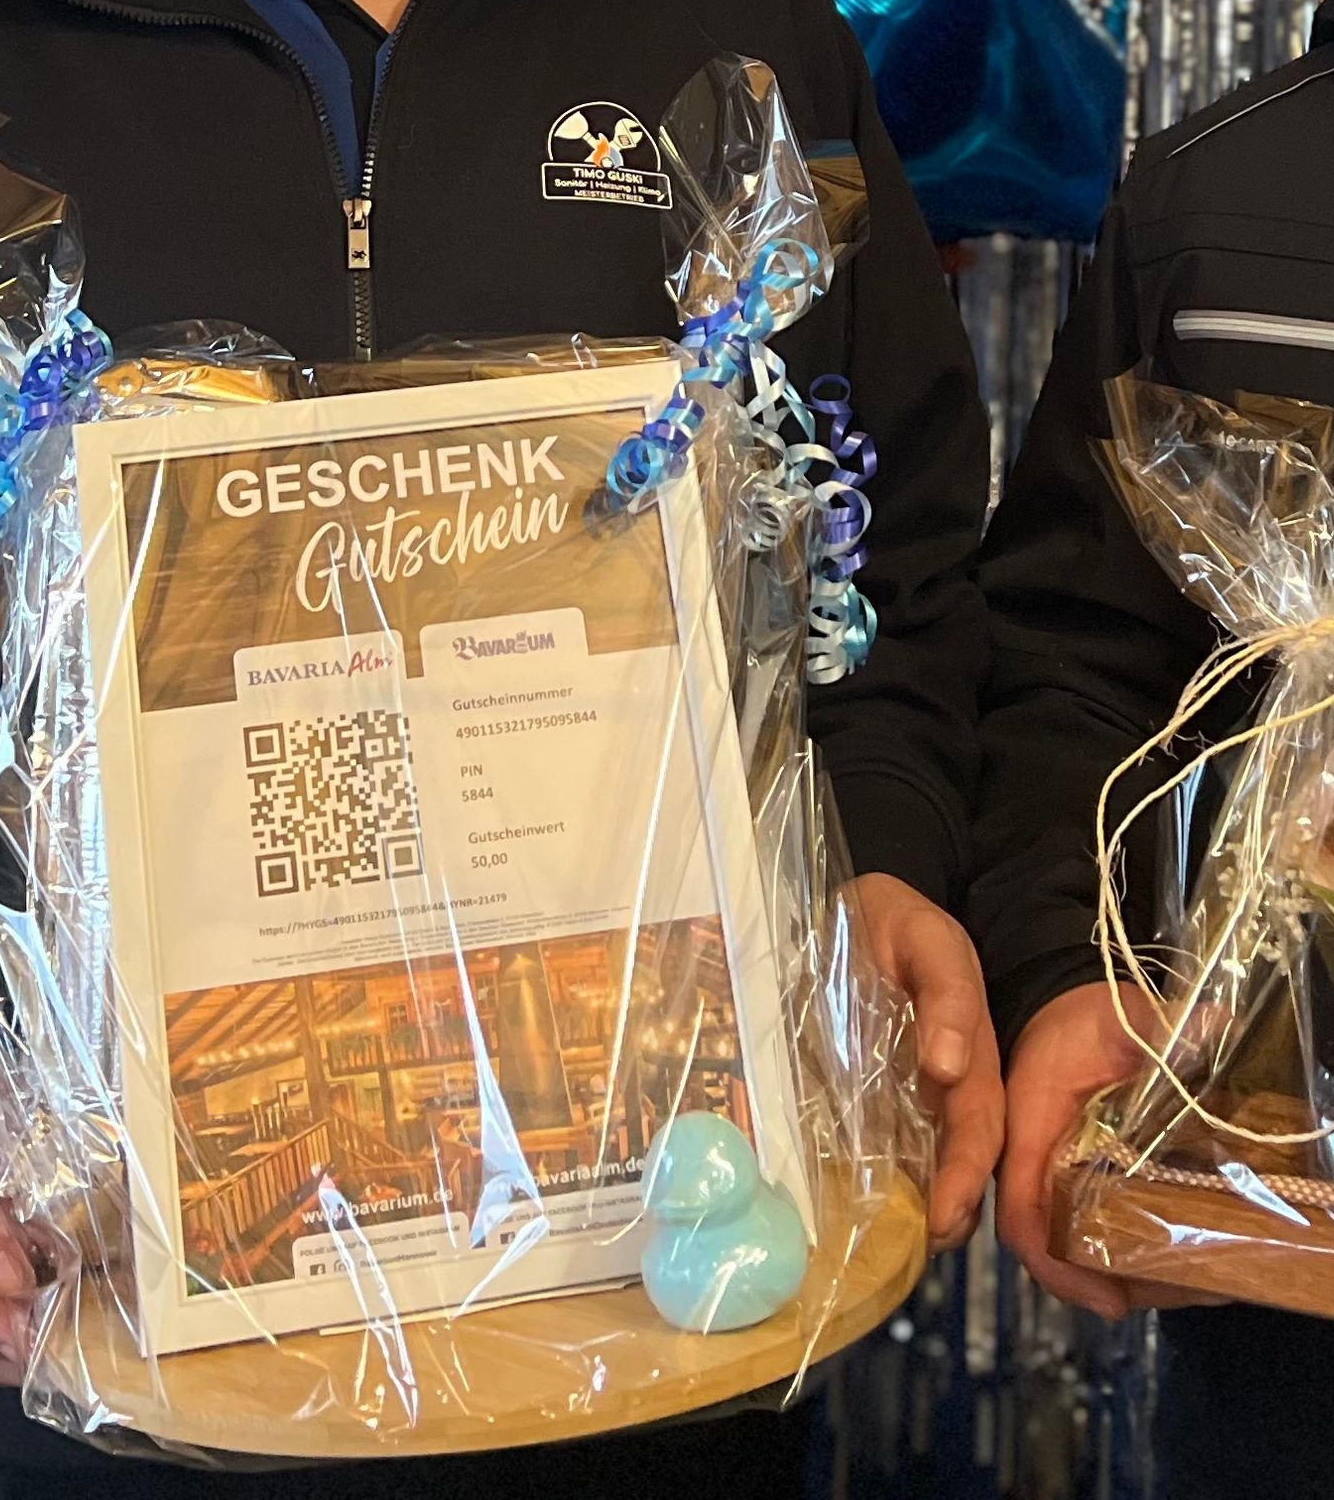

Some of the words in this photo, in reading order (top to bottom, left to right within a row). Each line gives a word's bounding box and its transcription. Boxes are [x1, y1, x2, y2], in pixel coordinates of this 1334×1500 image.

[572, 167, 606, 180] TIMO
[217, 435, 565, 517] GESCHENK
[295, 486, 569, 613] Gutschein
[247, 661, 345, 686] BAVARIA
[452, 686, 573, 712] Gutscheinnummer
[456, 710, 598, 739] 490115321795095844
[460, 764, 483, 778] PIN
[461, 787, 494, 802] 5844
[468, 821, 565, 845] Gutscheinwert
[471, 852, 508, 870] 50,00
[301, 1189, 454, 1224] wwbavarium.de
